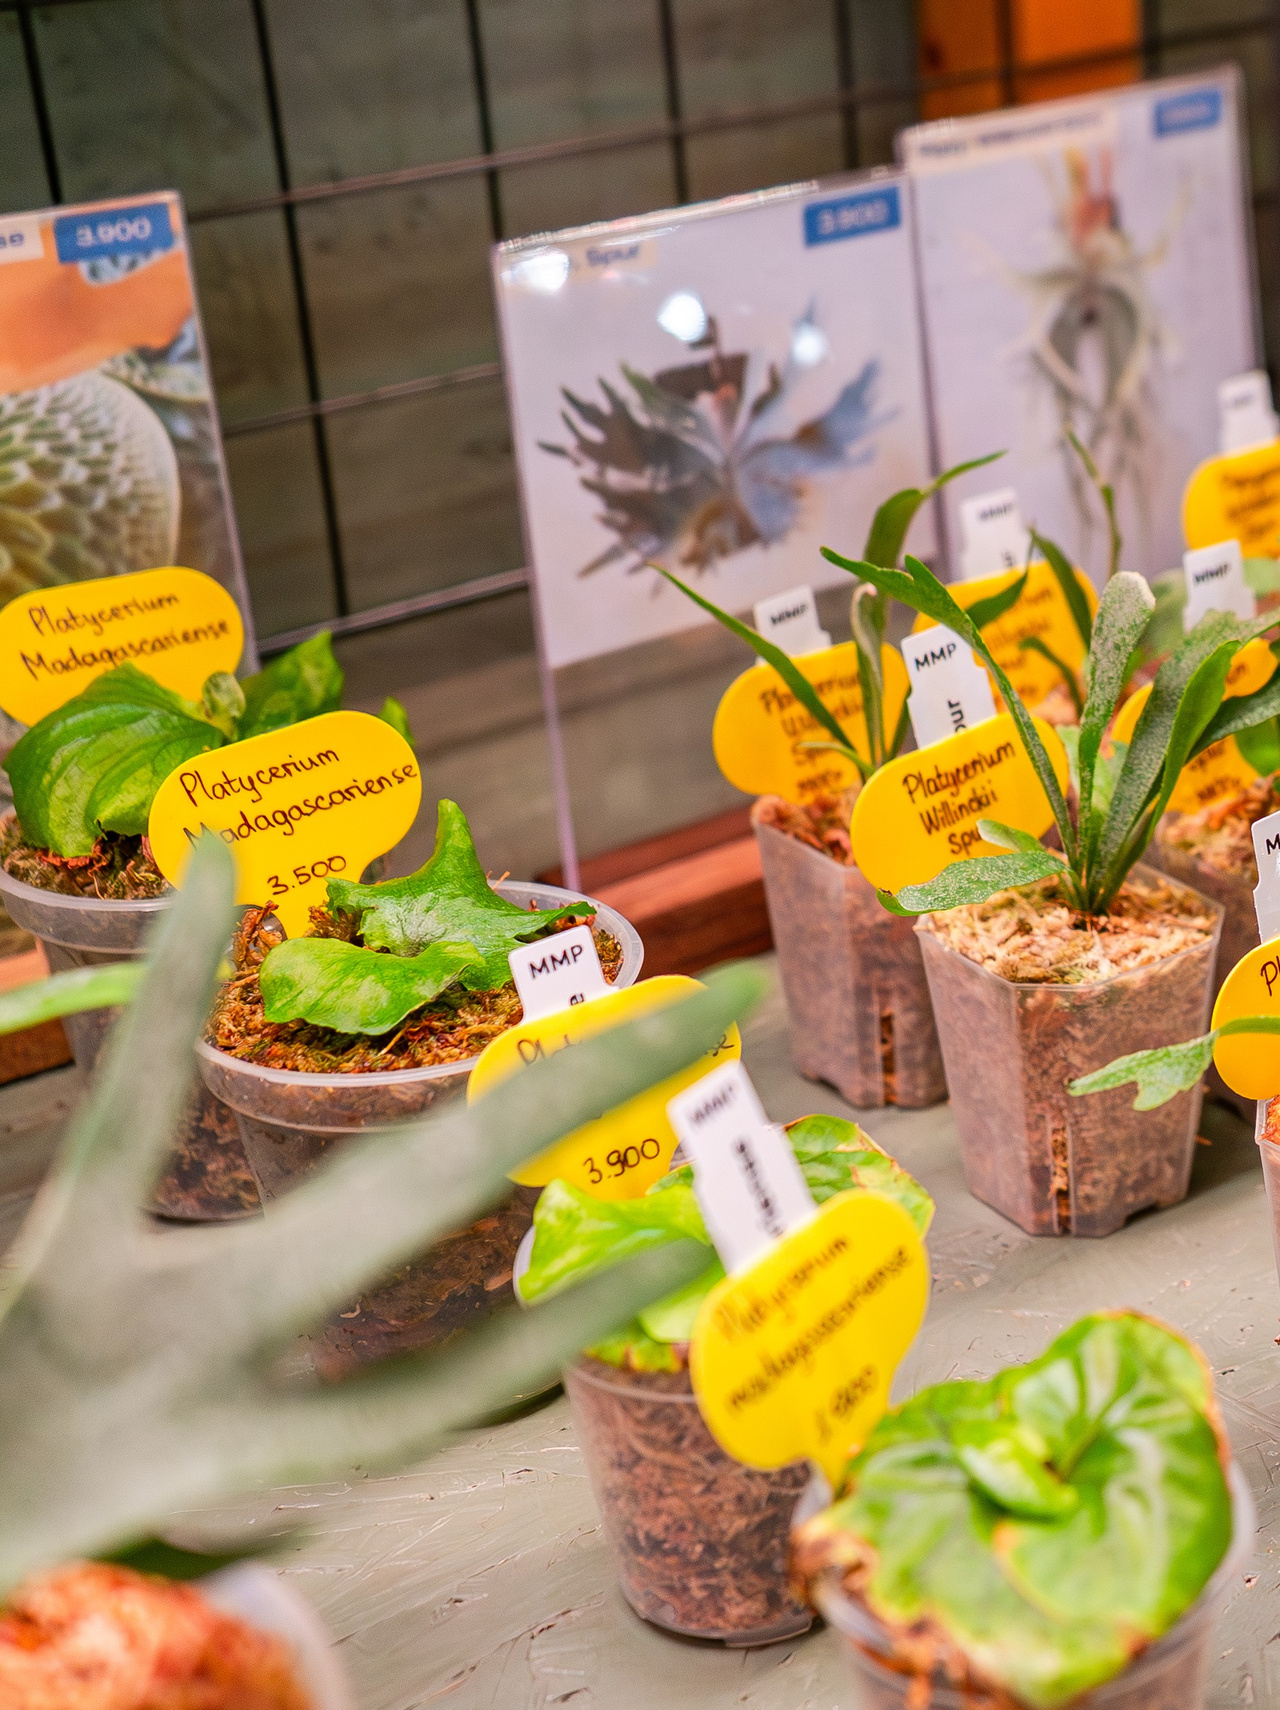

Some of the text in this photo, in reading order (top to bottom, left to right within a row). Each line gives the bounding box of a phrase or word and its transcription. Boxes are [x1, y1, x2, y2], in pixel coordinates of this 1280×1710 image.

[28, 592, 180, 637] Platycerium
[914, 643, 957, 672] MMP
[180, 748, 340, 808] Platycerium
[902, 741, 1017, 805] Platycerium
[266, 854, 348, 897] 3.500
[529, 944, 583, 979] MMP
[582, 1138, 661, 1185] 3.900
